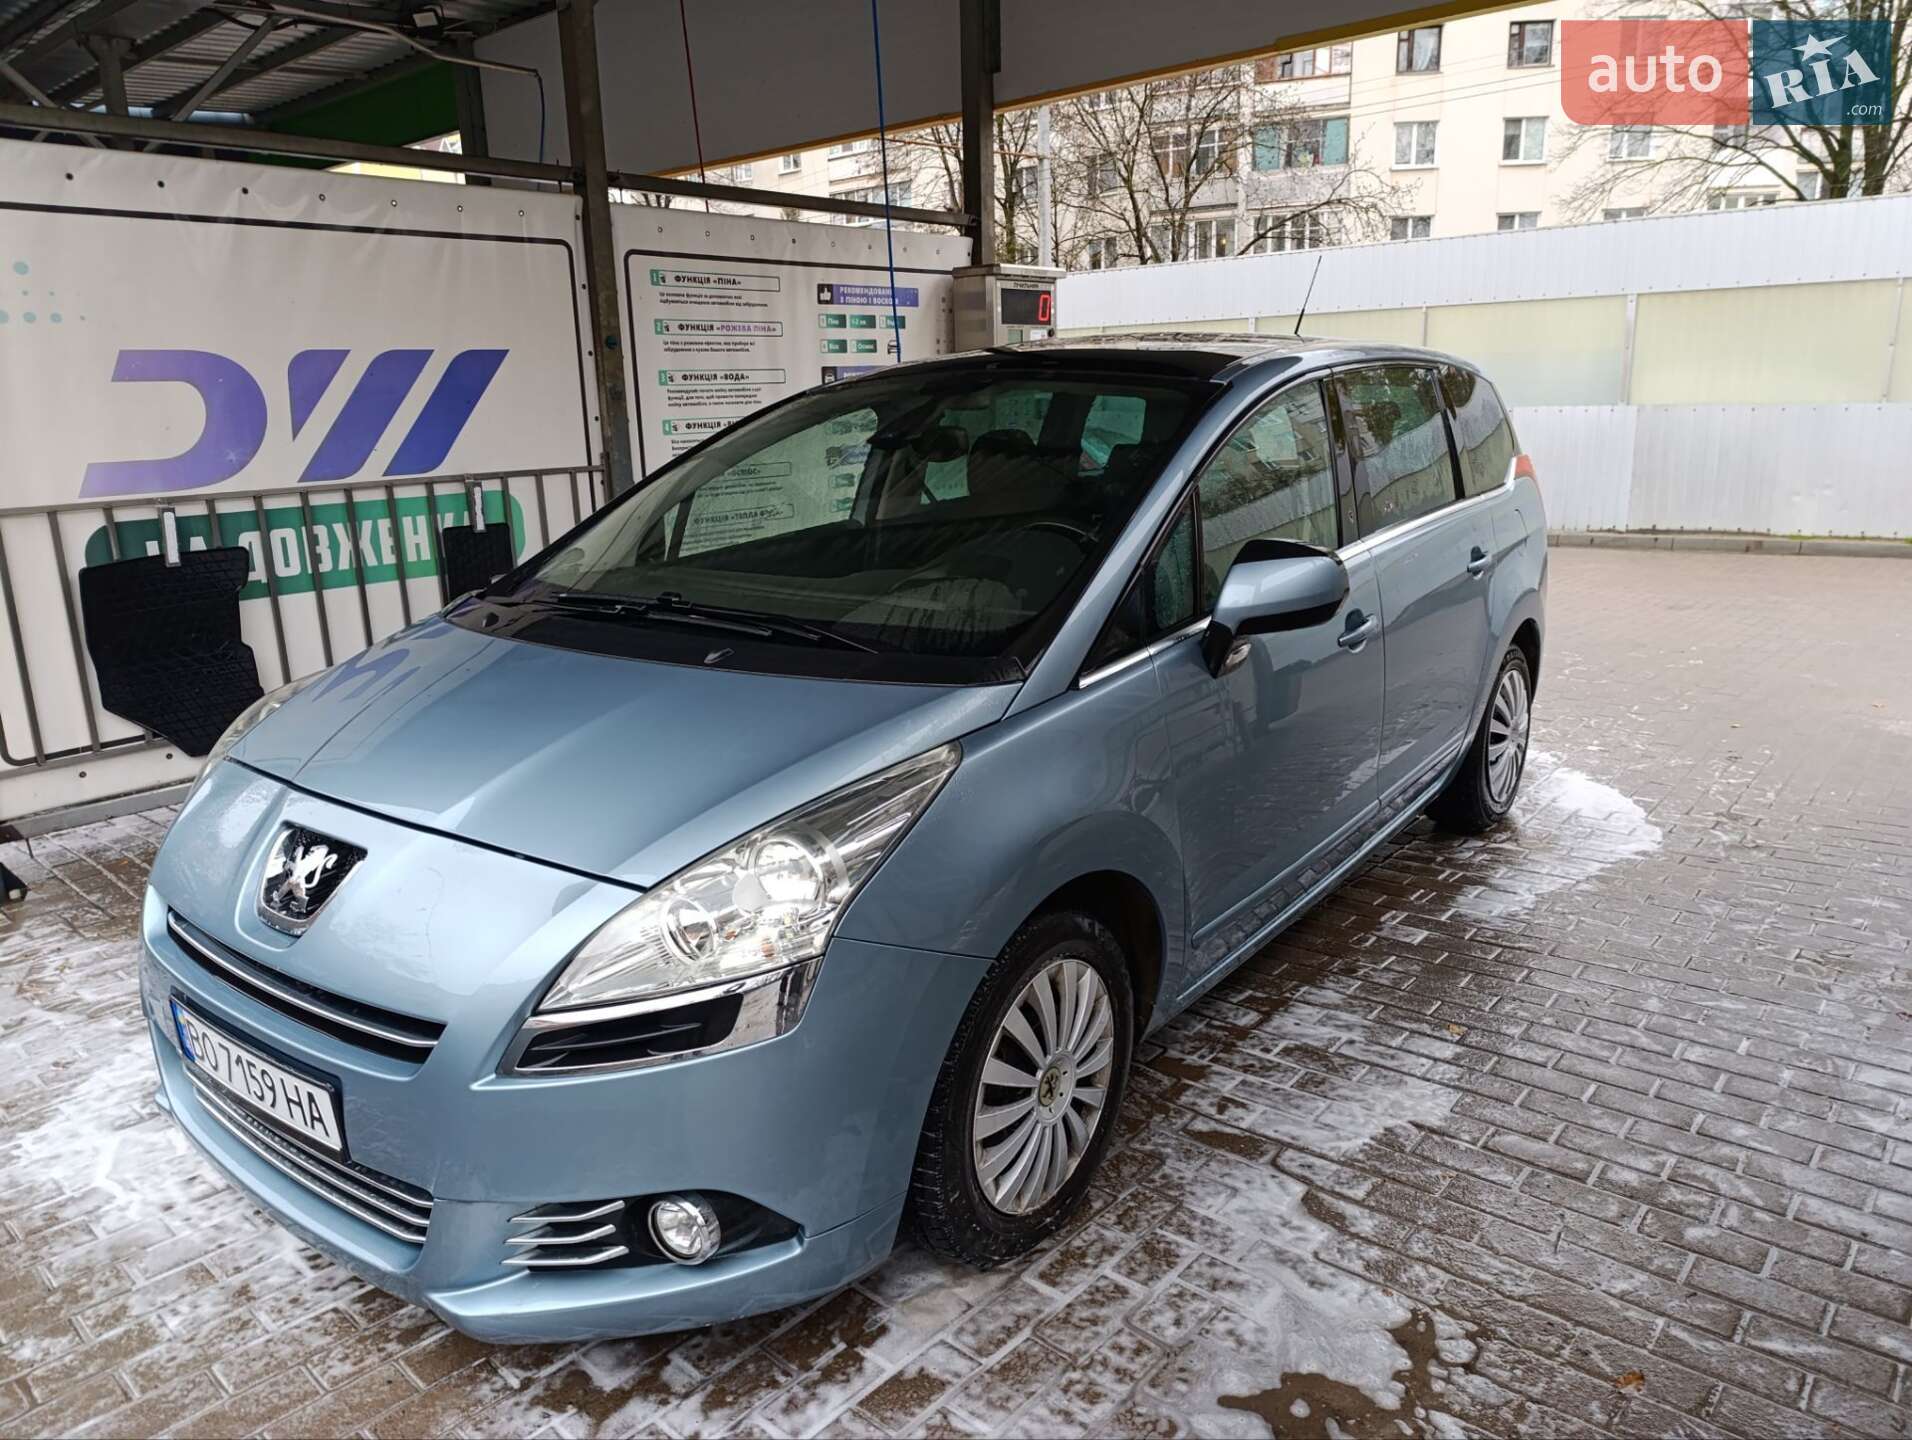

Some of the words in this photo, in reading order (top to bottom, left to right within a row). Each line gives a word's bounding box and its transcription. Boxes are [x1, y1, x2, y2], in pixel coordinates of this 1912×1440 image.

[674, 275, 711, 285] ФУНКЦІЯ
[1038, 294, 1051, 321] 0
[678, 323, 714, 333] ФУНКЦІЯ
[681, 373, 718, 382] ФУНКЦІЯ
[685, 421, 721, 431] ФУНКЦІЯ
[238, 511, 472, 583] ДОВЖЕН
[185, 1018, 219, 1072] BO
[218, 1043, 277, 1109] 7159
[280, 1077, 330, 1138] HA
